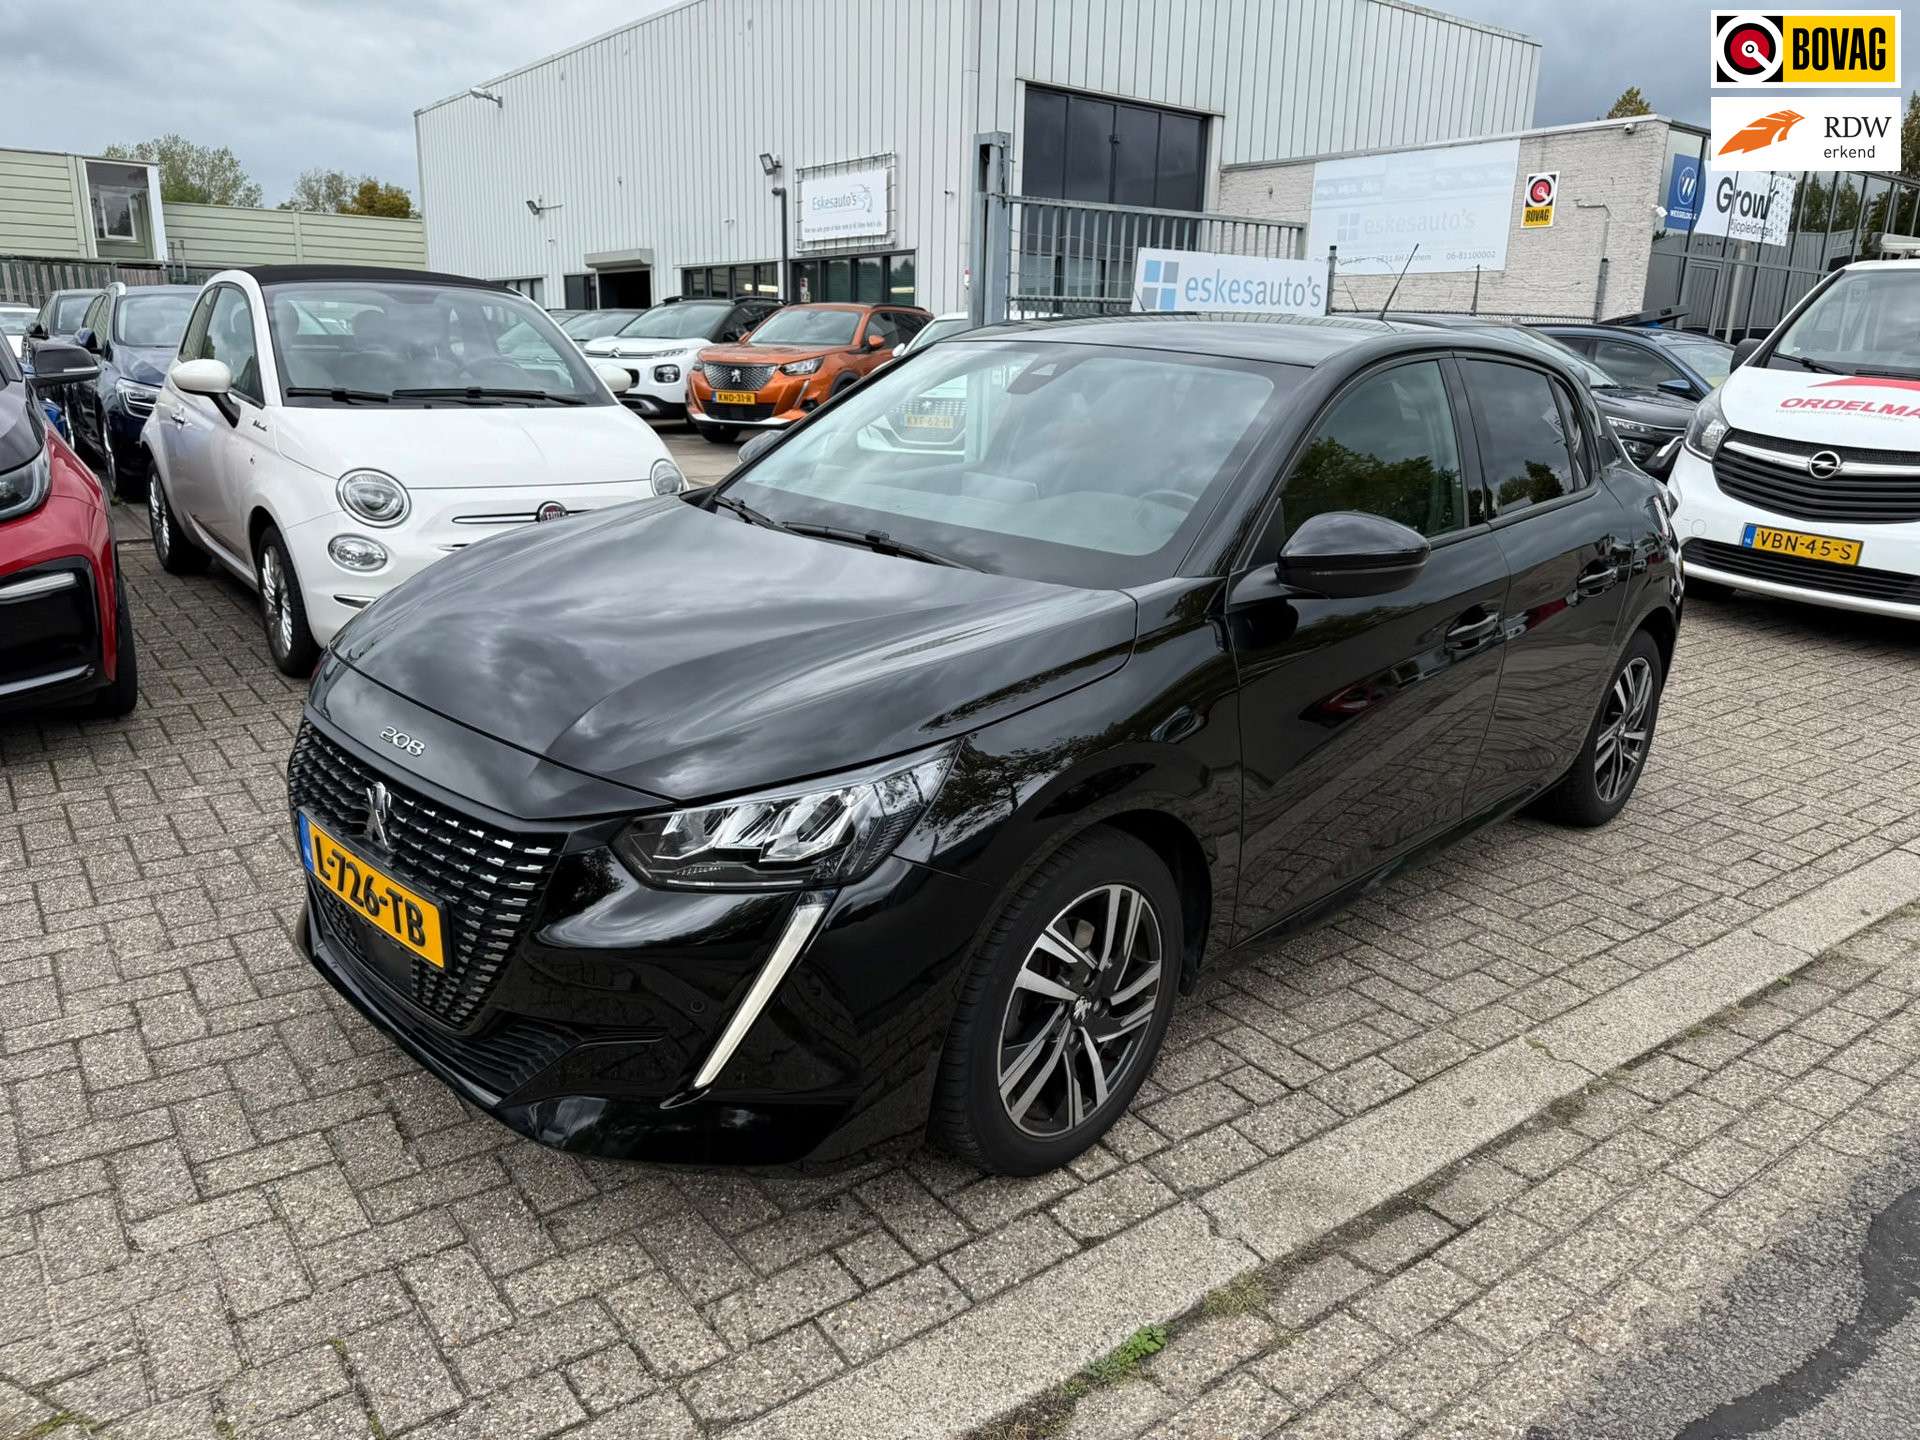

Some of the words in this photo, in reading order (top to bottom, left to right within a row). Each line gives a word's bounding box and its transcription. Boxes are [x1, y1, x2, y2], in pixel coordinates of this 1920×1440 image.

[1525, 208, 1550, 222] BOVAG
[1185, 268, 1321, 308] eskesauto's
[1759, 530, 1852, 560] VBN-45-S
[380, 726, 425, 756] 208
[315, 835, 425, 947] L-726-TB
